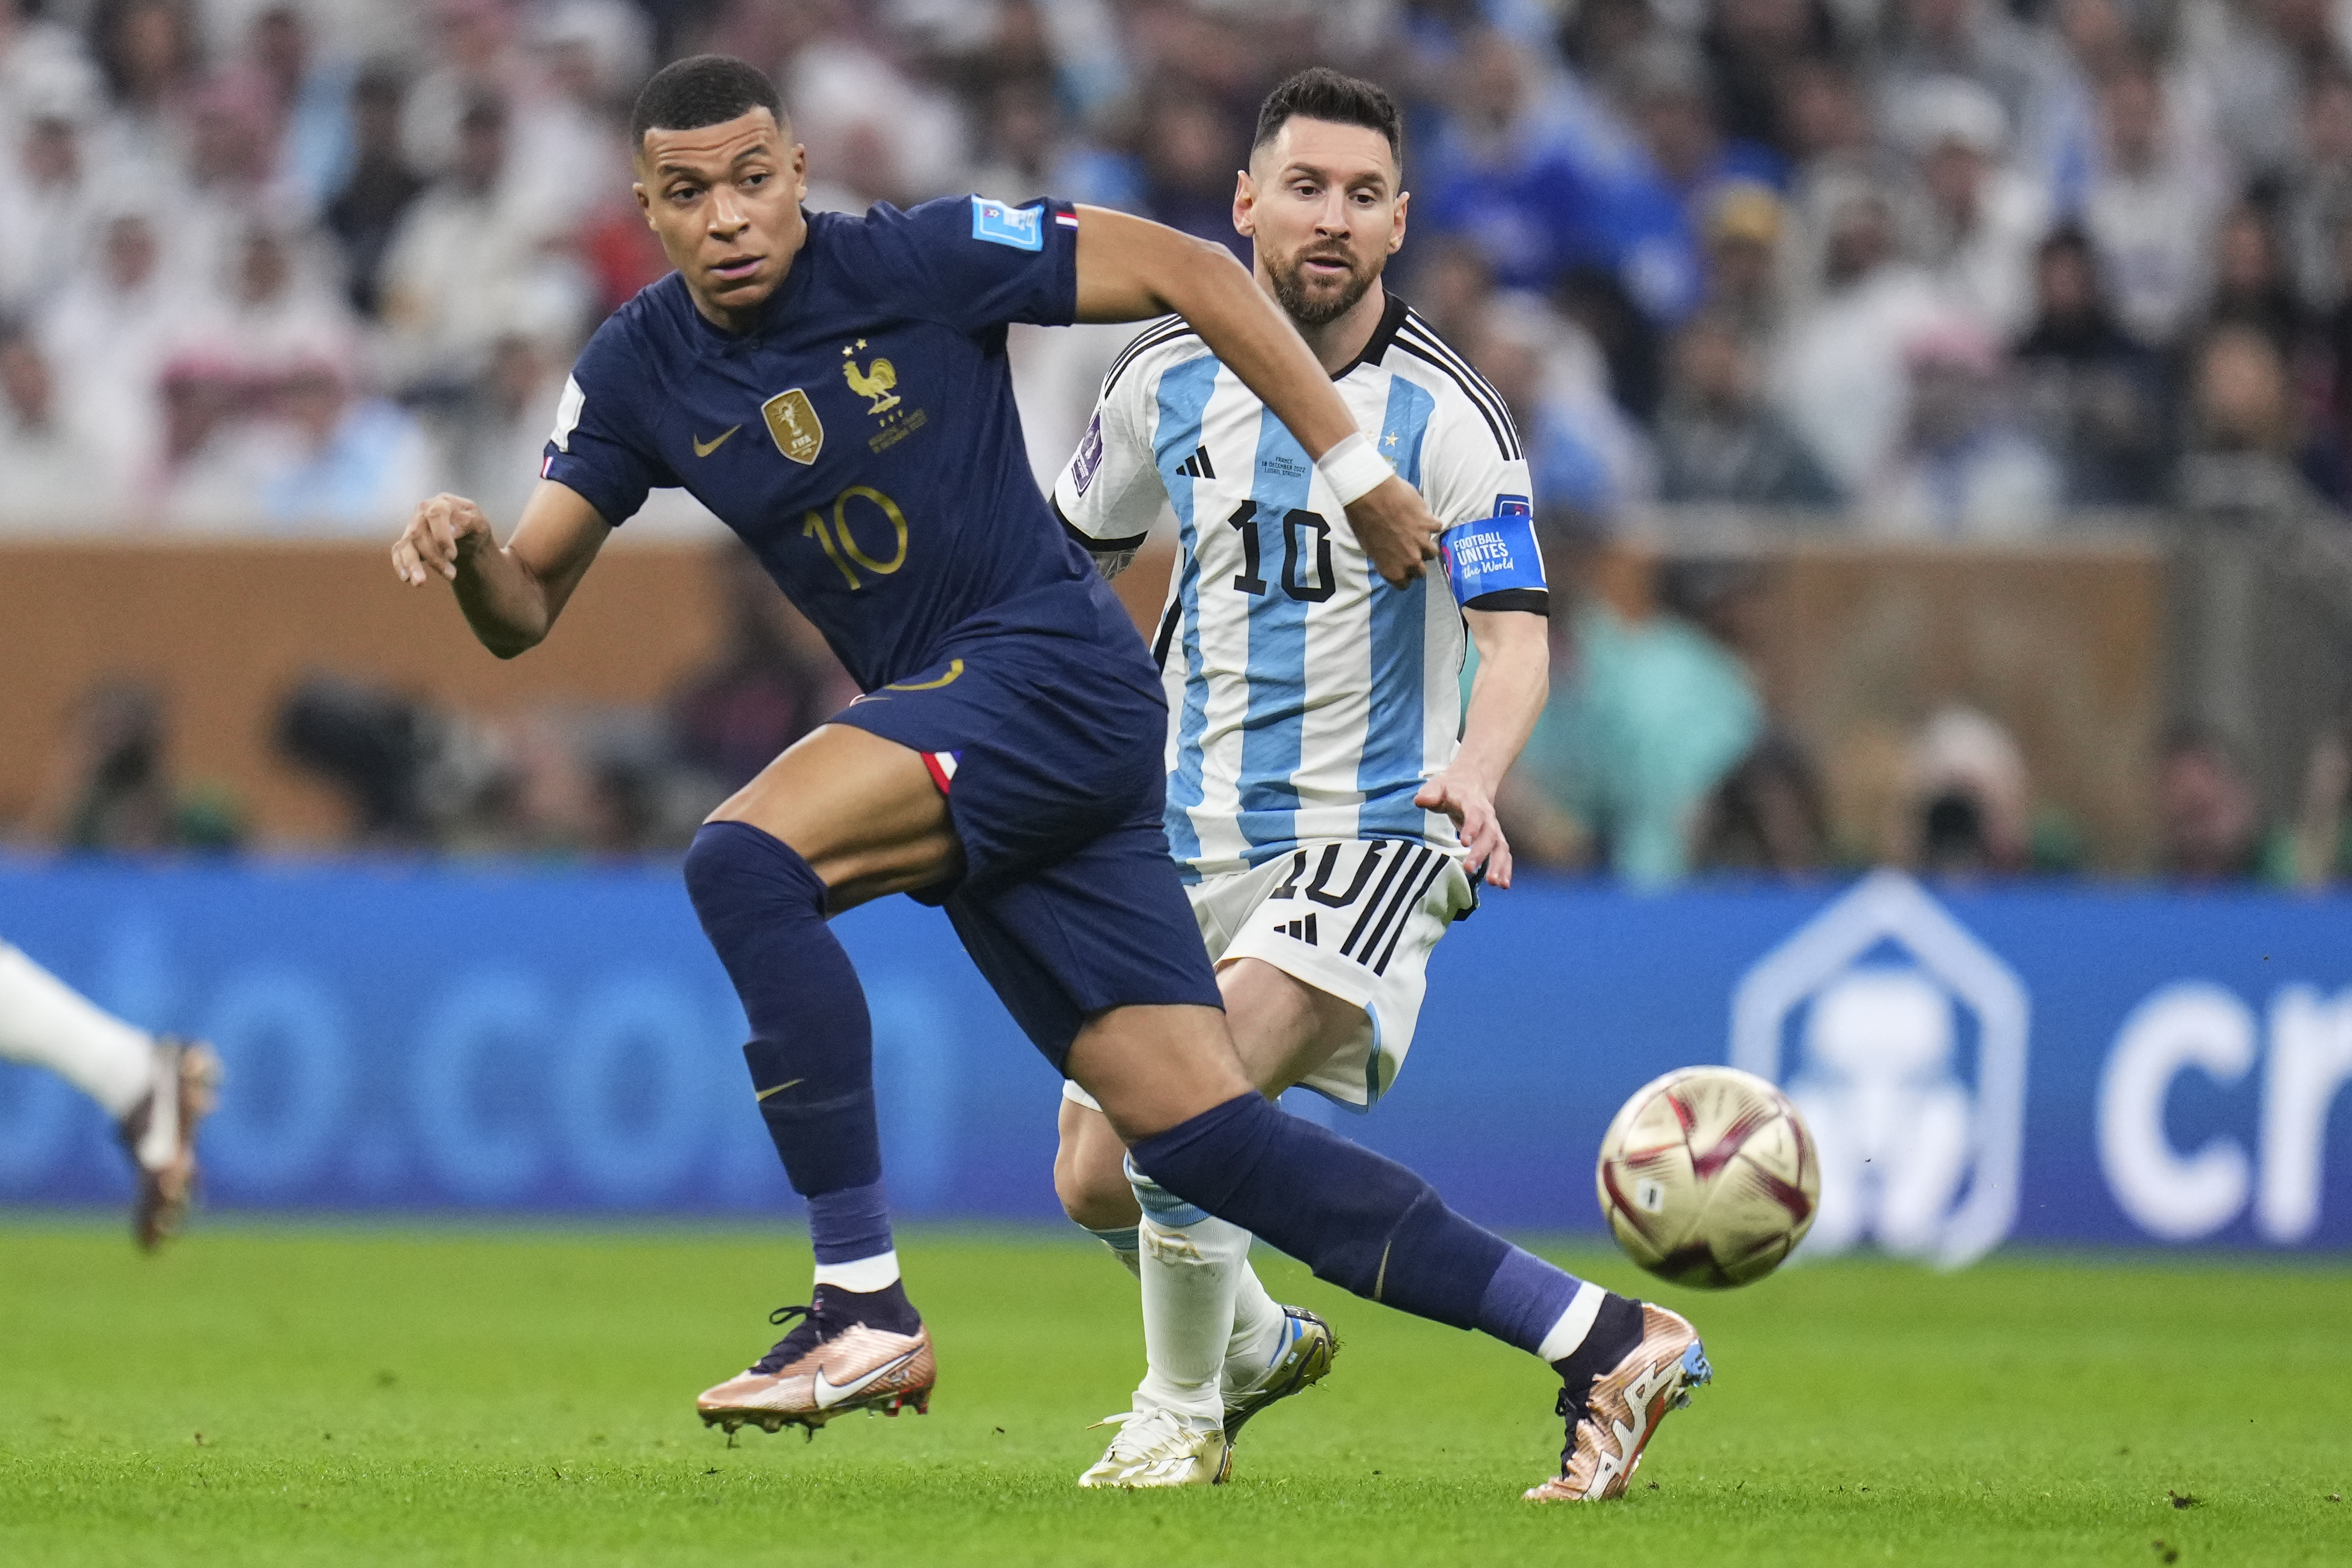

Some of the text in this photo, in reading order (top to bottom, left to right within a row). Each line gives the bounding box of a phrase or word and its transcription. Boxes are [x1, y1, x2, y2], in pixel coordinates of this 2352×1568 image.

[1269, 462, 1293, 471] DECEMBER
[803, 485, 908, 591] 10
[1453, 531, 1504, 552] FOOTBALL
[1228, 499, 1336, 603] 10
[1457, 543, 1509, 565] UNITES
[1462, 557, 1514, 579] the World
[1268, 840, 1387, 909] 10
